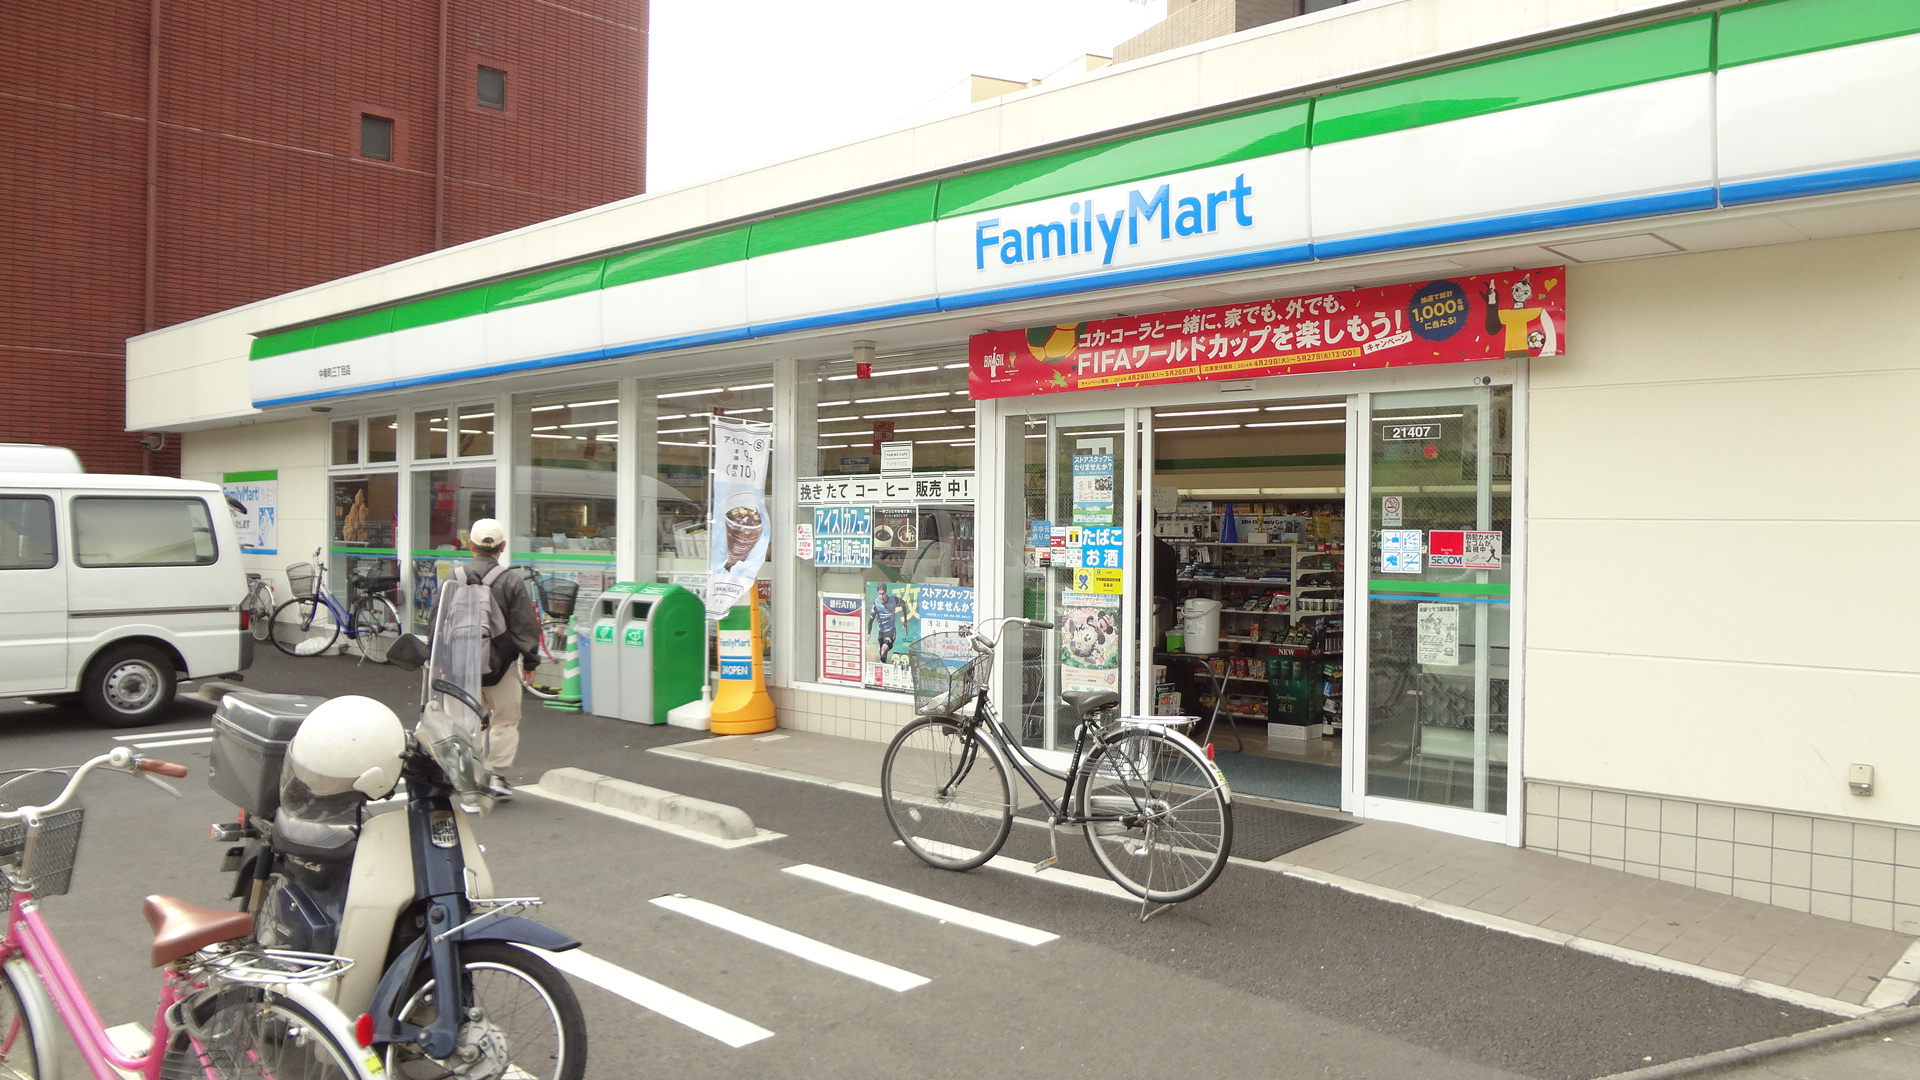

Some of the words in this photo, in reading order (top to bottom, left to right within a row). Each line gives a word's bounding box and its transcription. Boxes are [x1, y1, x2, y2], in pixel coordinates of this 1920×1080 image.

[976, 173, 1253, 270] FamilyMart
[1421, 290, 1453, 304] 抽選で総計
[1412, 300, 1457, 323] 1,000
[1425, 317, 1457, 330] に当たる!
[1366, 335, 1411, 351] キャンペーン
[984, 353, 1004, 368] BRASIL
[1392, 426, 1431, 438] 21407
[1082, 528, 1123, 546] たばこ
[1086, 549, 1119, 567] お酒
[1431, 556, 1462, 565] SECOM
[830, 600, 857, 609] 銀行ATM
[891, 584, 920, 620] 攻
[921, 599, 974, 613] なりませんか?
[1278, 648, 1295, 656] NEW
